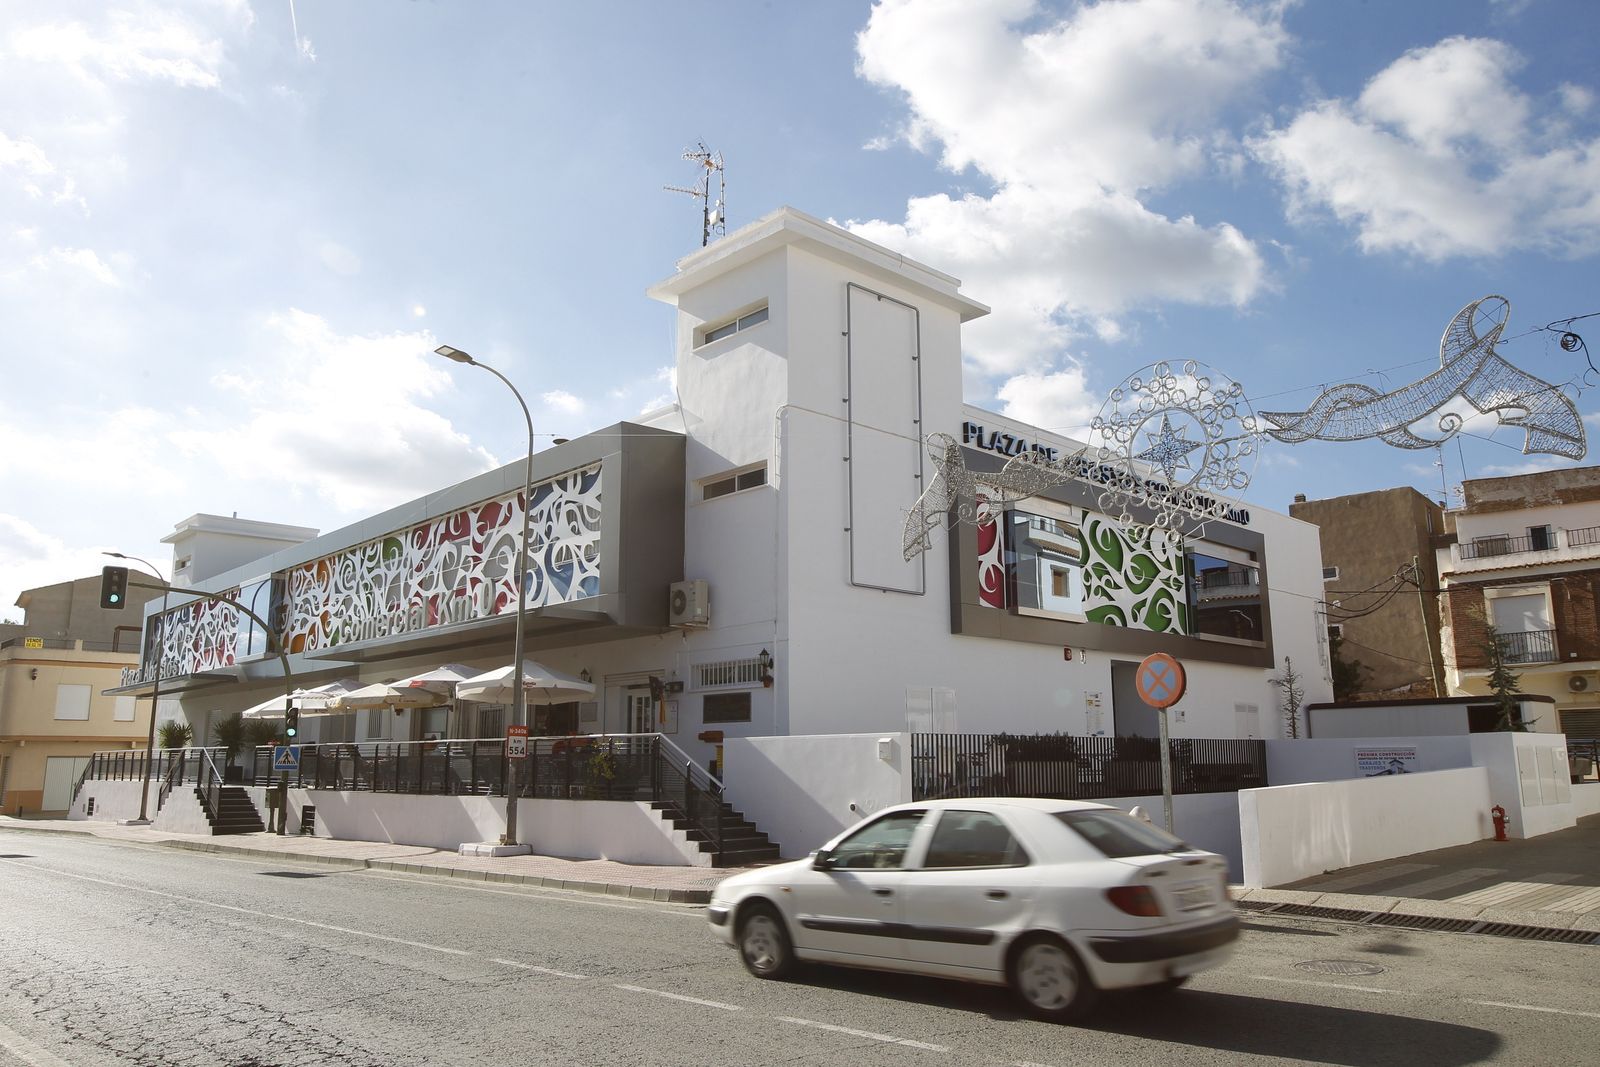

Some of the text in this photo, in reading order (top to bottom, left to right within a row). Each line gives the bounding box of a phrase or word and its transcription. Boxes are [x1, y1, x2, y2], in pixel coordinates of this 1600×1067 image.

[963, 421, 1030, 456] PLAZA
[1031, 443, 1059, 464] DE
[339, 578, 497, 643] Comercial Km.0
[120, 667, 144, 687] Plaza
[509, 747, 525, 755] 554
